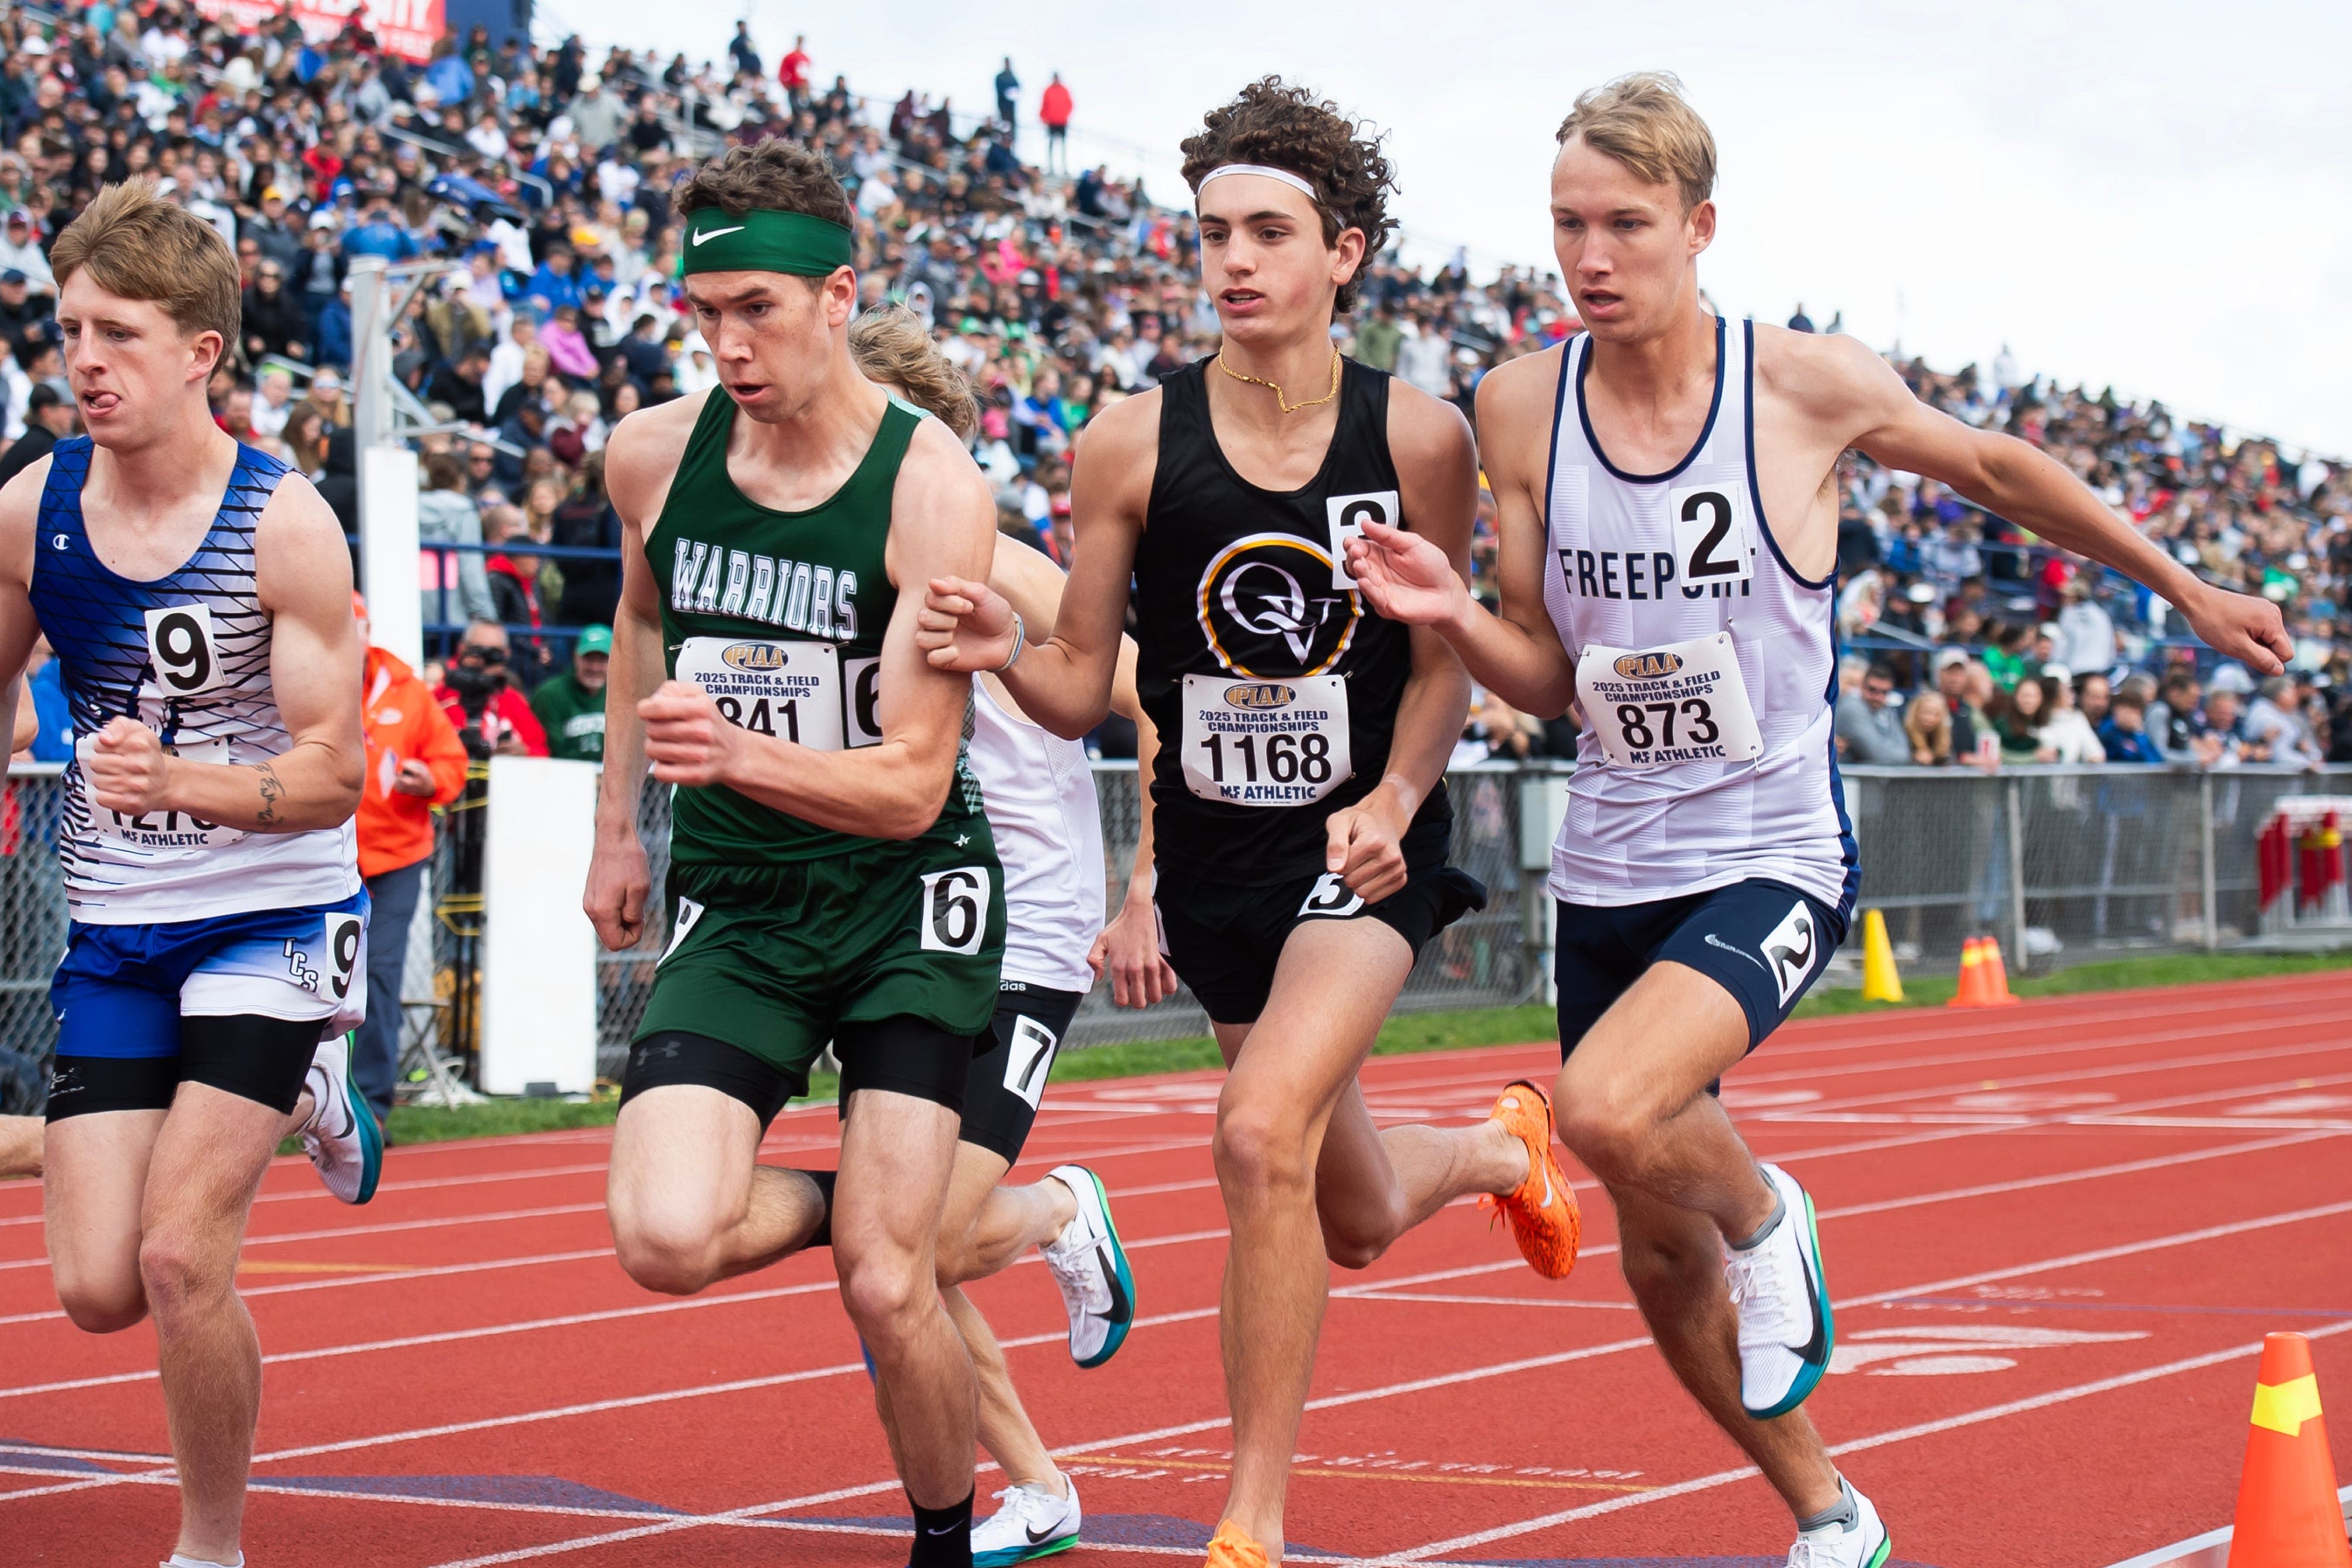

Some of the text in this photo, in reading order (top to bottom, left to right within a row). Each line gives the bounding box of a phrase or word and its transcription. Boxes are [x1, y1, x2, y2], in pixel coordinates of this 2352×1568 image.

[1681, 491, 1740, 579] 2
[1558, 547, 1756, 600] FREEP
[672, 537, 858, 641] WARRIORS
[156, 612, 210, 690] 9
[731, 646, 785, 666] PIAA
[1622, 653, 1679, 676] PIAA
[695, 673, 819, 686] 2025 TRACK & FIELD
[1593, 682, 1624, 692] 2025
[1625, 680, 1670, 692] TRACK
[1684, 670, 1721, 686] FIELD
[706, 684, 811, 698] CHAMPIONSHIPS
[1234, 686, 1291, 706] PIAA
[1605, 684, 1714, 702] CHAMPIONSHIPS
[1199, 710, 1230, 721] 2025
[1234, 712, 1277, 722] TRACK
[1294, 711, 1328, 720] FIELD
[1208, 721, 1319, 733] CHAMPIONSHIPS
[1617, 698, 1720, 749] 873
[1200, 733, 1332, 783] 1168
[1654, 745, 1726, 763] ATHLETIC
[1243, 785, 1317, 799] ATHLETIC
[141, 833, 208, 846] ATHLETIC
[932, 872, 979, 948] 6
[332, 920, 360, 999] 9
[1769, 918, 1811, 995] 2
[1017, 1023, 1051, 1093] 7
